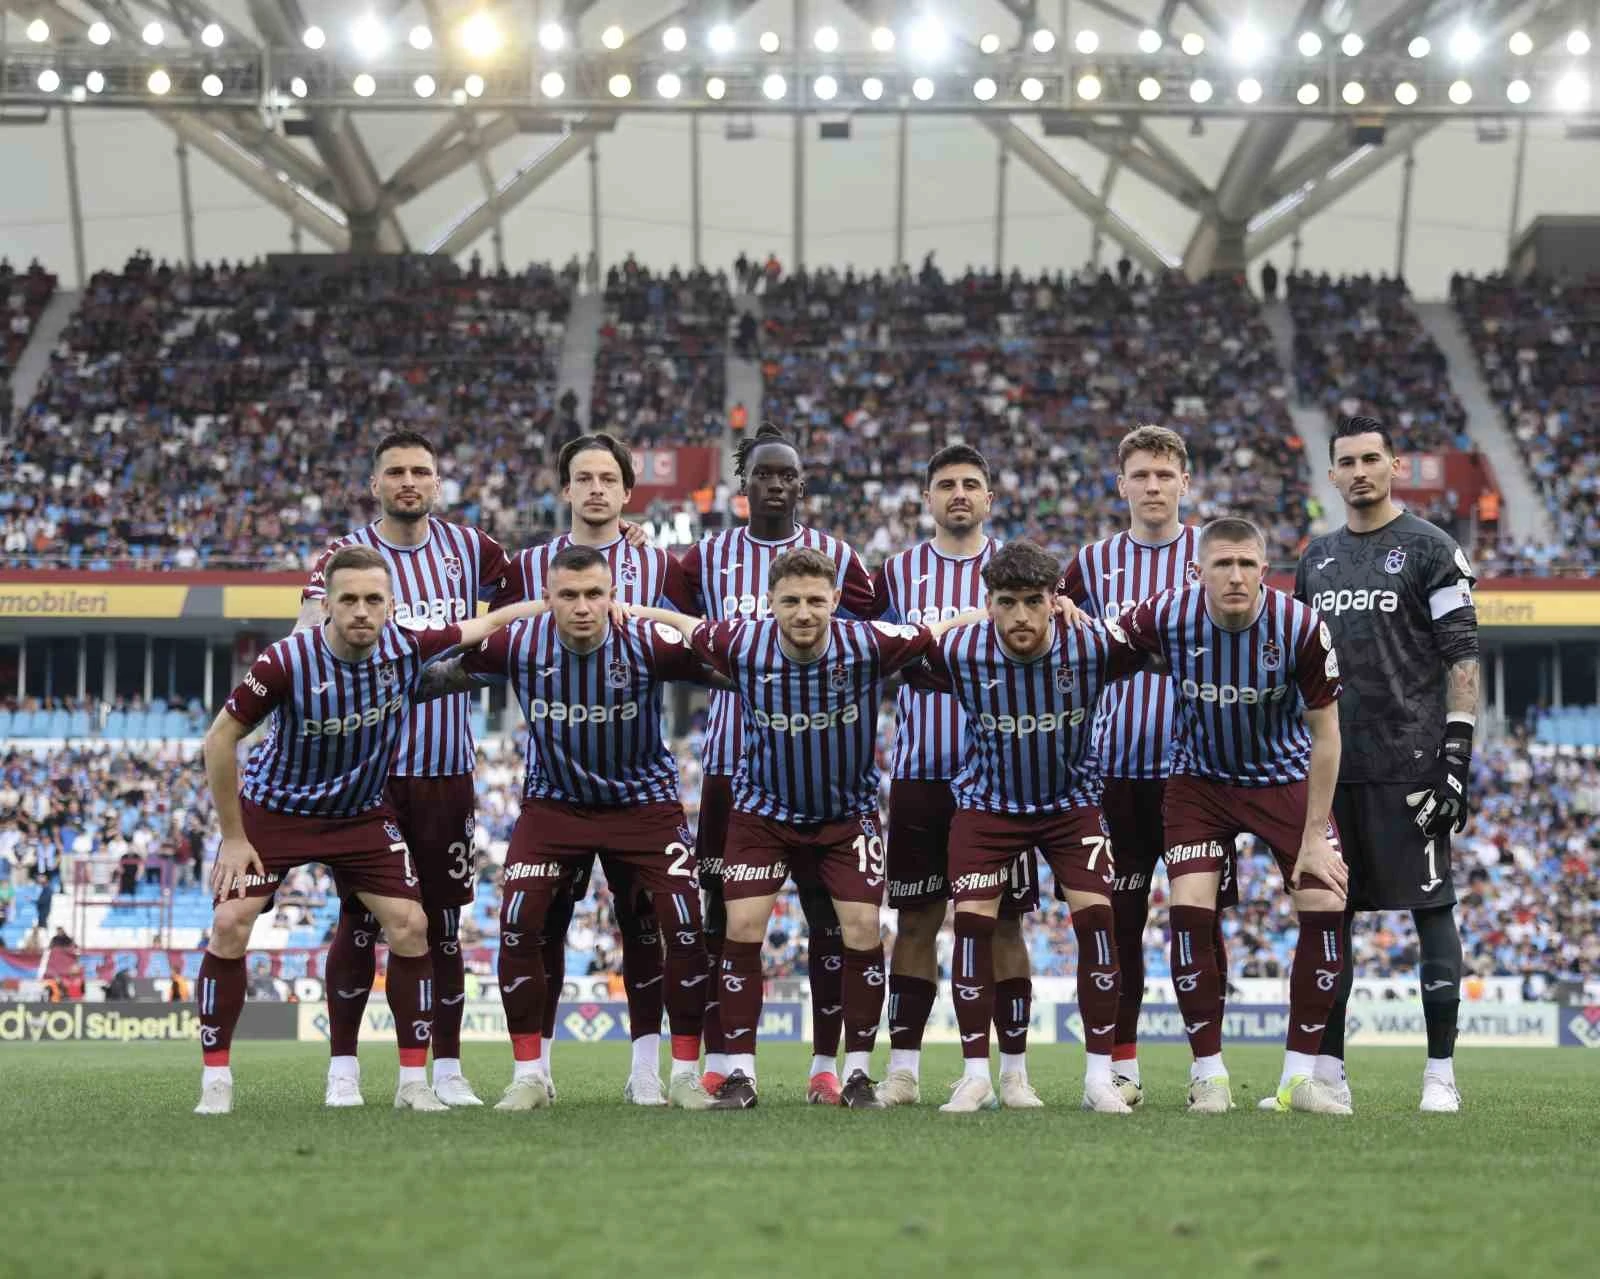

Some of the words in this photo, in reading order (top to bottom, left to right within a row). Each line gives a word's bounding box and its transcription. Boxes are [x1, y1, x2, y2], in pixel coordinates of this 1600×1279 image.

[303, 694, 402, 736] papara
[530, 699, 638, 727] papara
[390, 842, 411, 878] 7
[852, 834, 885, 875] 19
[1172, 842, 1208, 864] Rent
[733, 863, 771, 881] Rent
